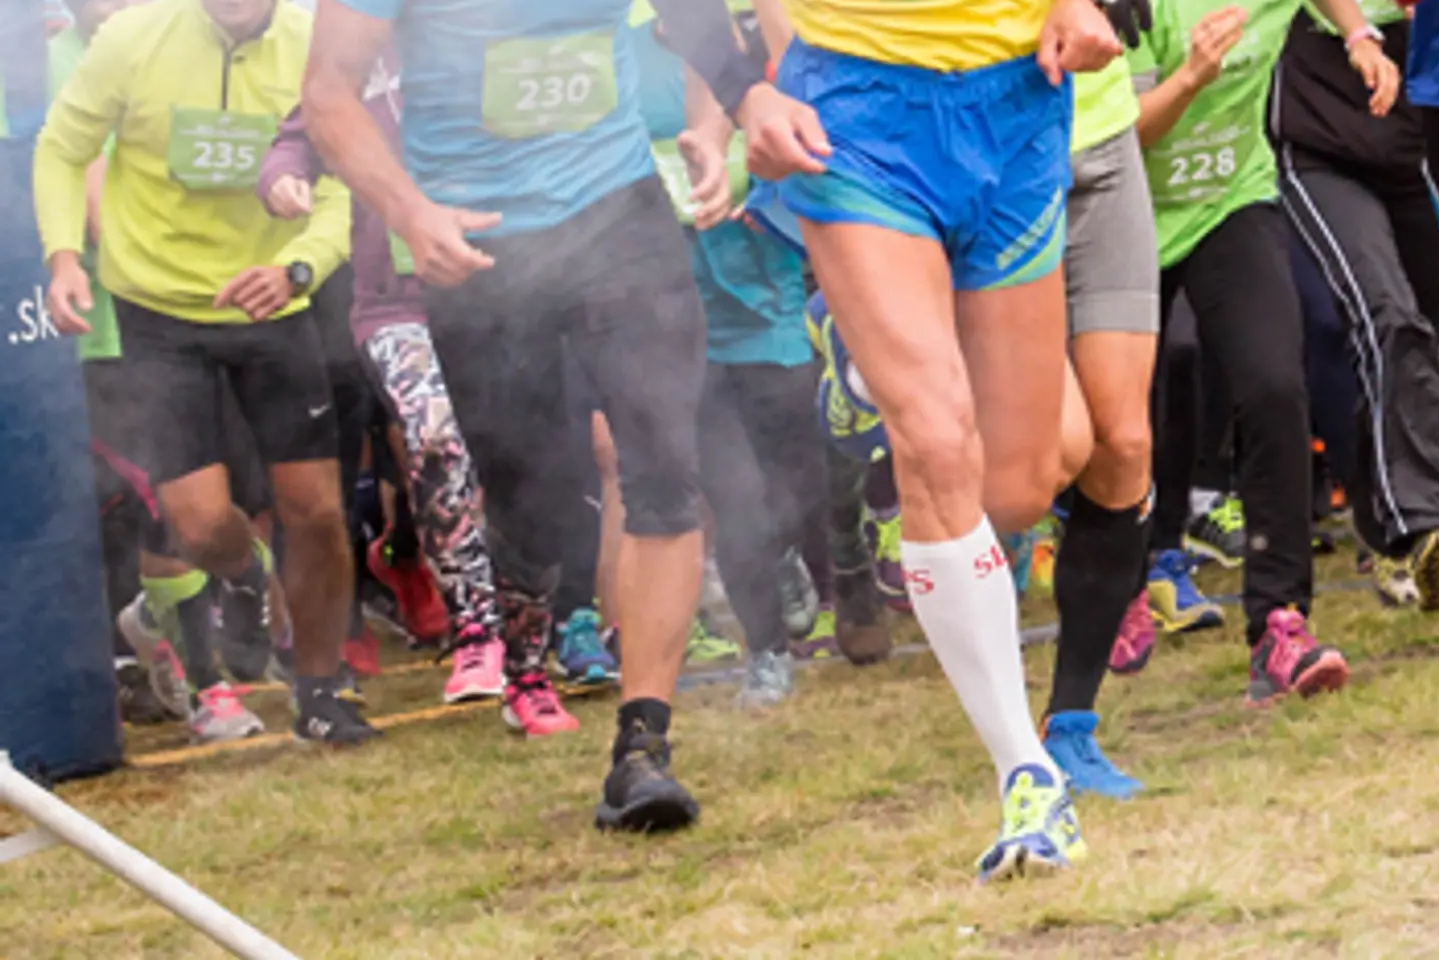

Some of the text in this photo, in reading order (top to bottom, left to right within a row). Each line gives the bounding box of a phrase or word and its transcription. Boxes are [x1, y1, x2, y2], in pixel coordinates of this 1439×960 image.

[516, 72, 591, 110] 230
[193, 141, 255, 169] 235
[1168, 147, 1236, 185] 228
